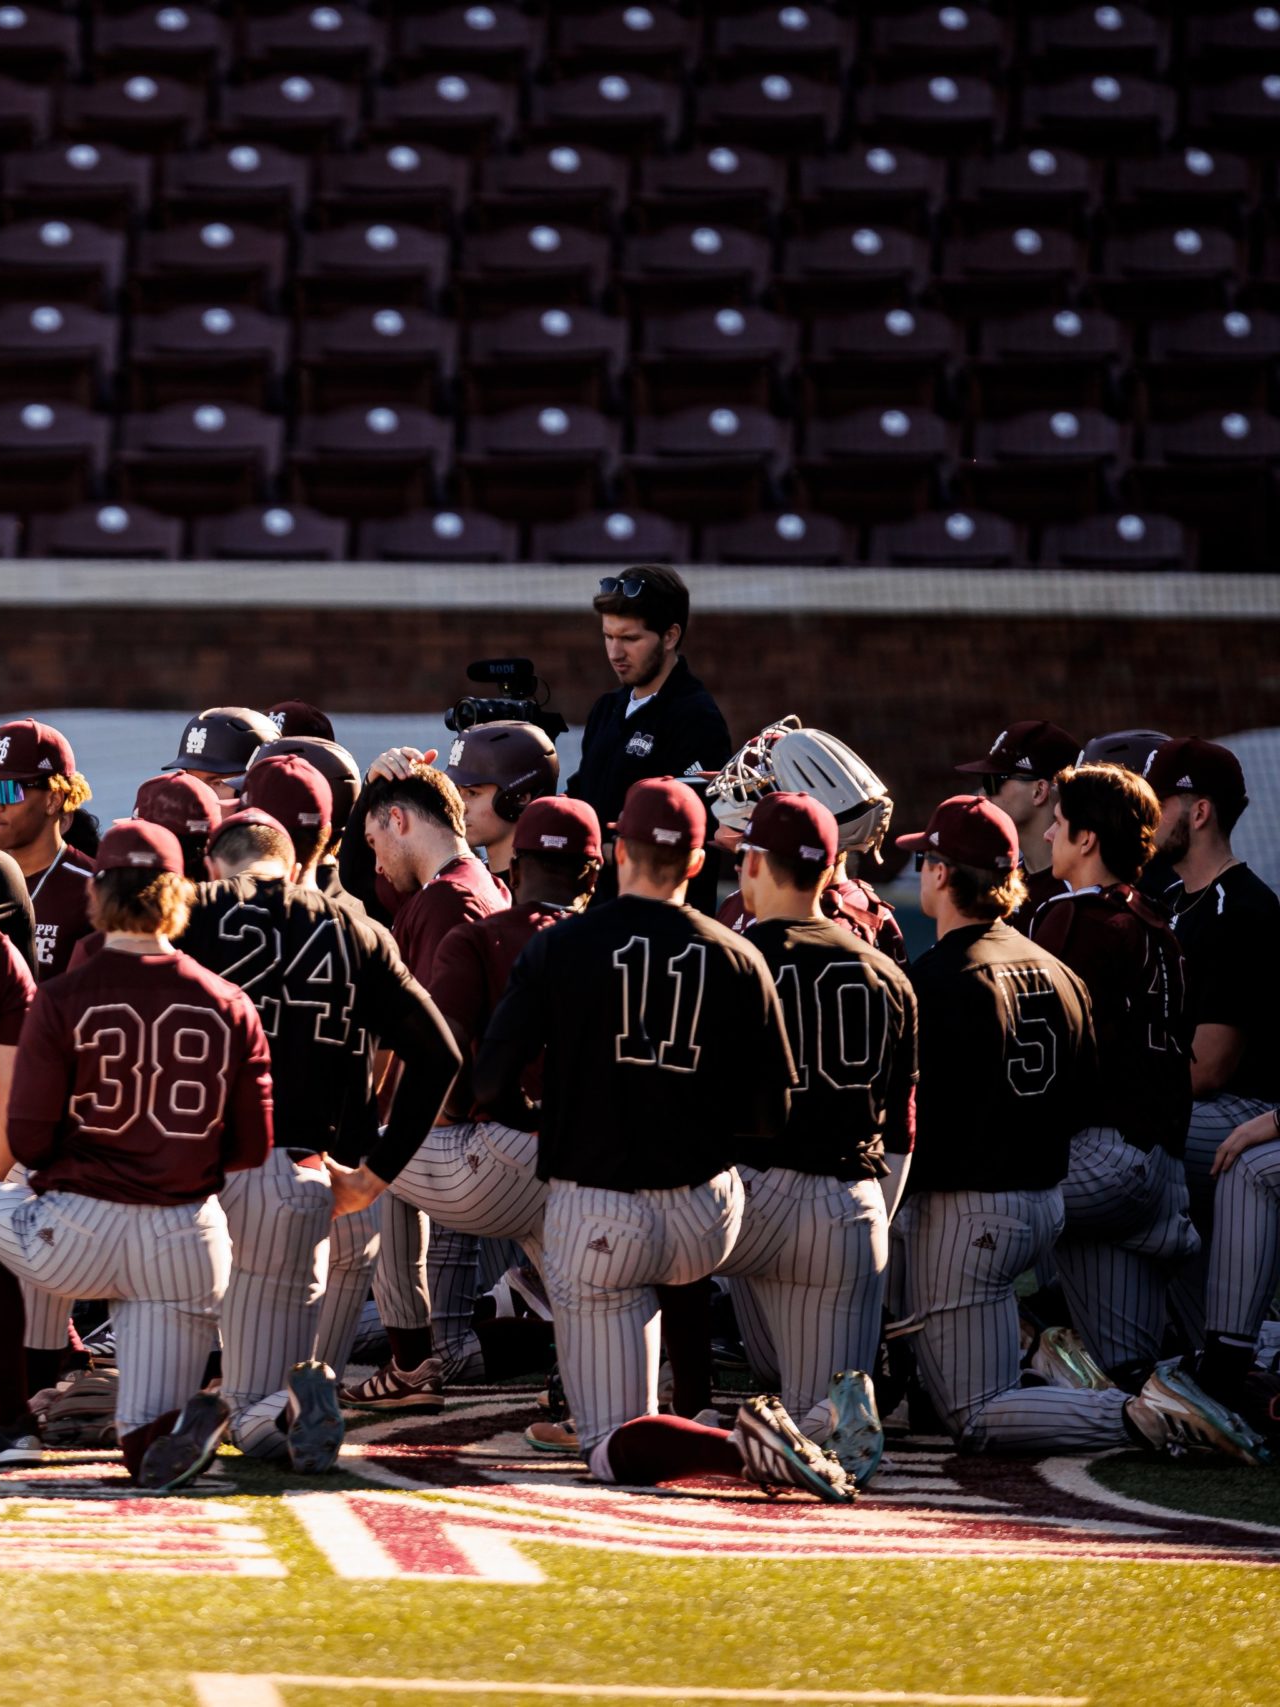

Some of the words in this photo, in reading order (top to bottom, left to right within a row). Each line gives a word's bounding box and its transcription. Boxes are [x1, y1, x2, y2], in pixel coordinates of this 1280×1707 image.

[219, 902, 356, 1045] 24
[613, 935, 706, 1073] 11
[775, 962, 889, 1090] 10
[997, 968, 1056, 1096] 5
[70, 1003, 231, 1139] 38
